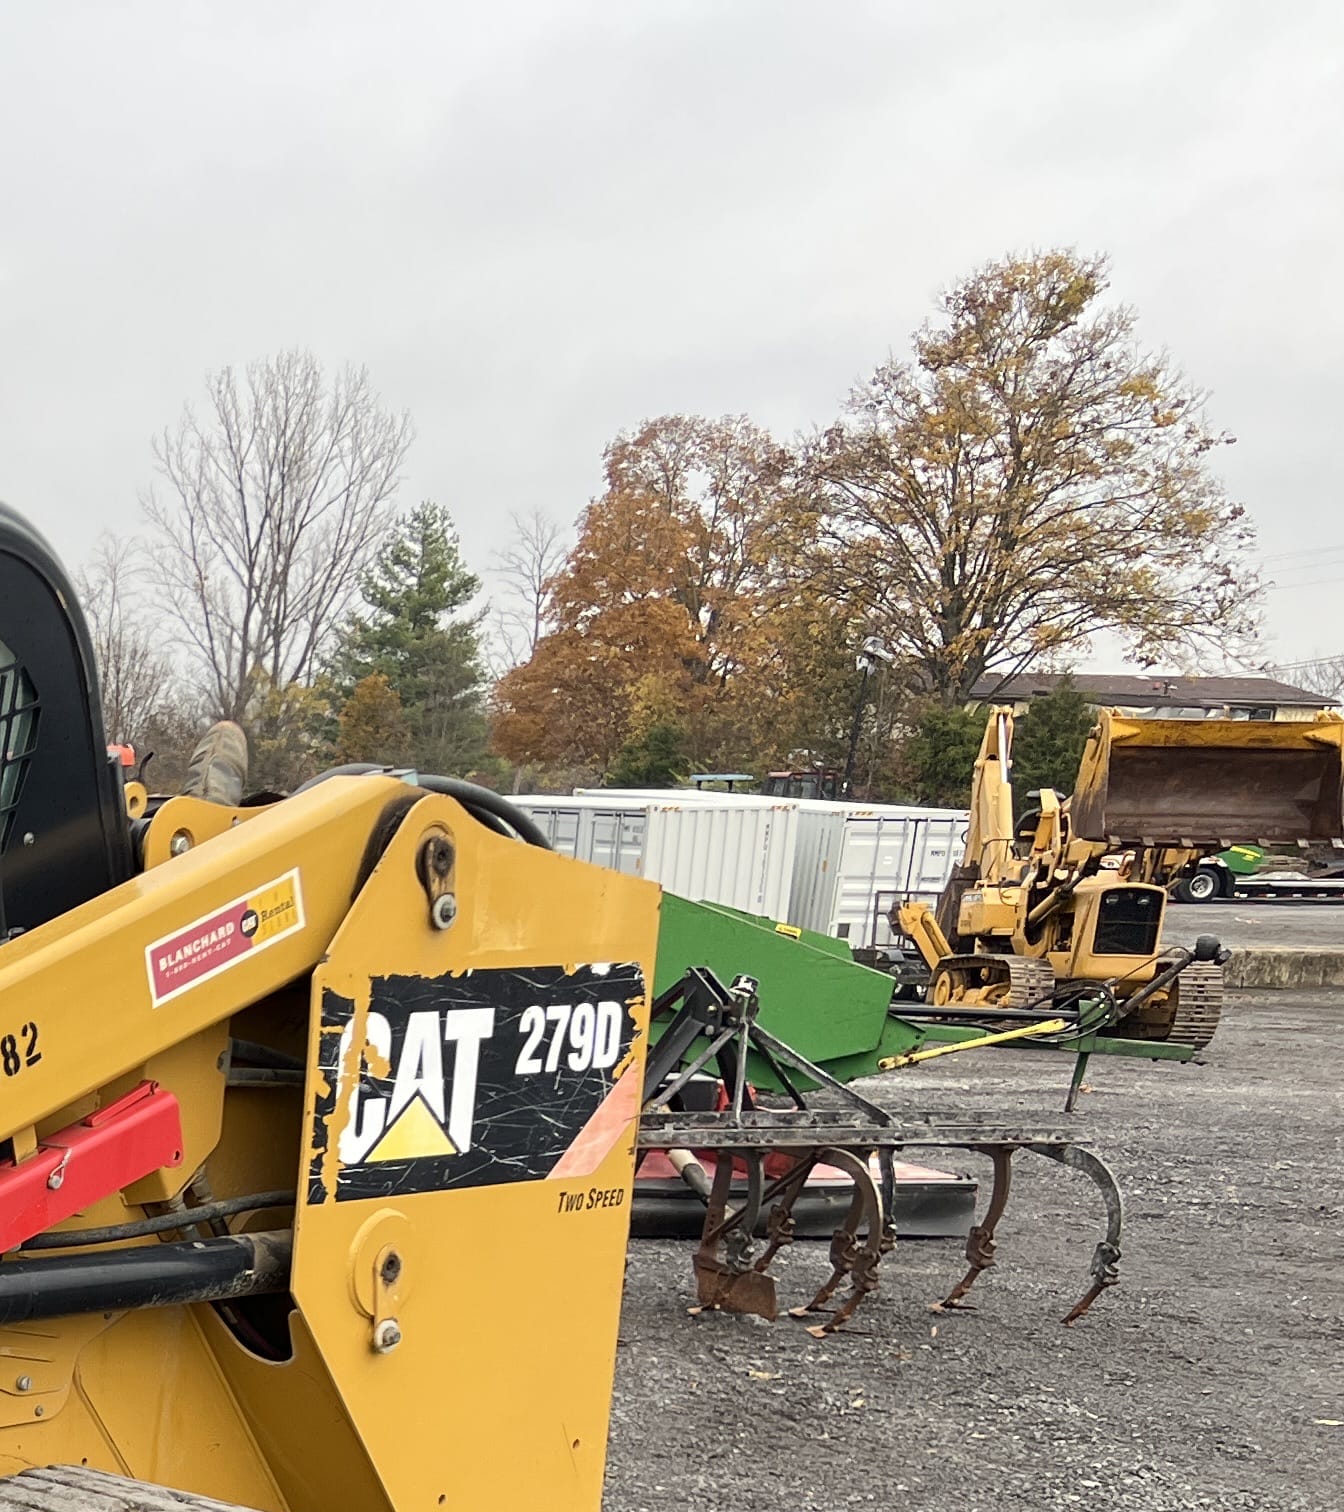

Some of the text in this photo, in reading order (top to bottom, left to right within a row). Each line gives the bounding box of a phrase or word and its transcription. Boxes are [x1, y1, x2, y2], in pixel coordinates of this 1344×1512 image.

[158, 921, 235, 972] BLANCHARD
[260, 896, 295, 922] Rental
[336, 1001, 623, 1165] CAT 279D
